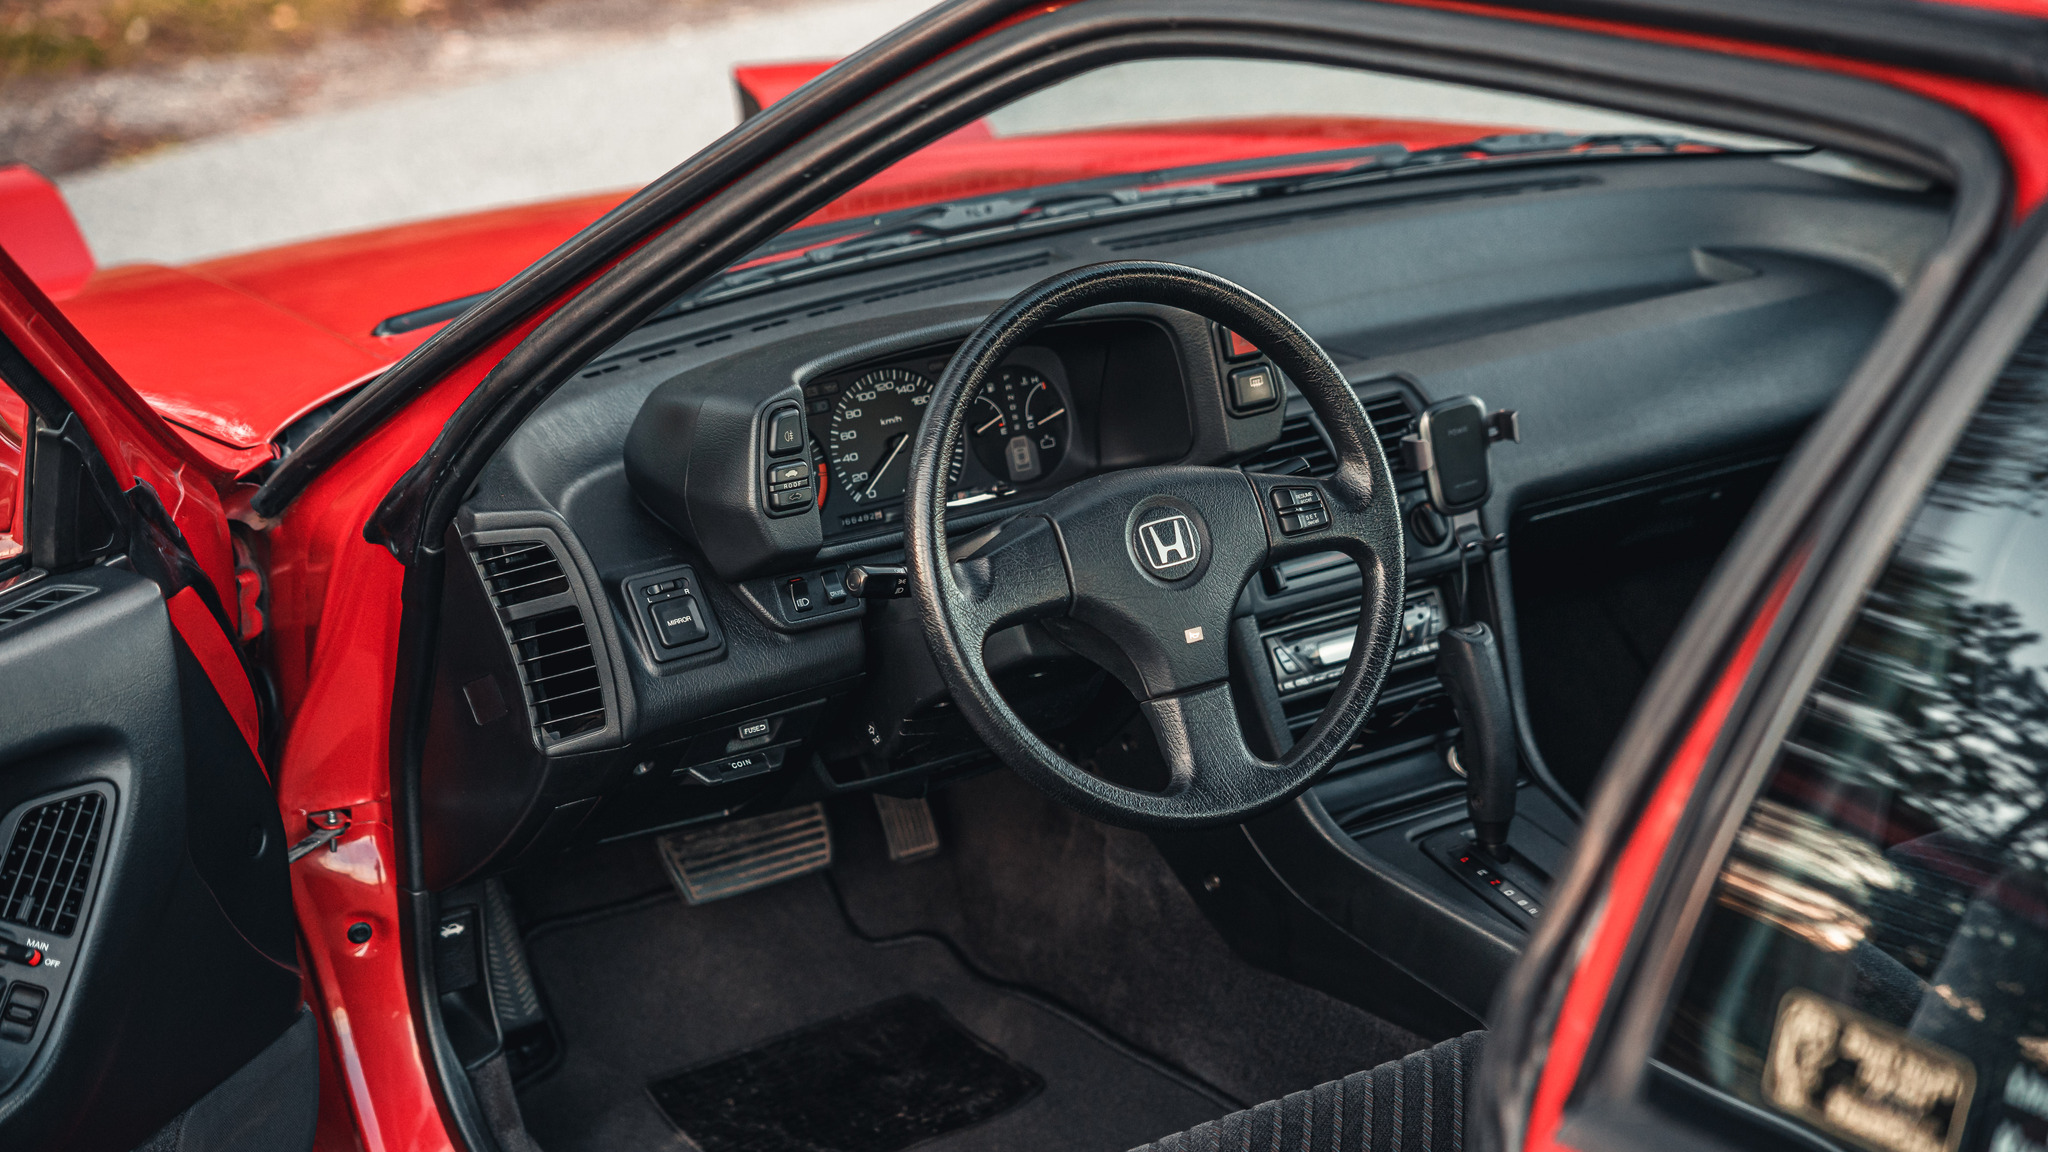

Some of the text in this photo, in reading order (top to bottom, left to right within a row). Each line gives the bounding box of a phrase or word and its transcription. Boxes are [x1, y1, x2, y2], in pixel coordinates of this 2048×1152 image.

[874, 381, 894, 392] 120
[895, 383, 915, 394] 140
[856, 391, 876, 401] 100
[911, 394, 930, 406] 160
[845, 409, 862, 419] 80
[880, 415, 902, 426] km/h
[840, 430, 857, 441] 60
[842, 452, 859, 462] 40
[851, 471, 868, 483] 20
[783, 481, 802, 490] ROOF
[867, 489, 877, 499] 0
[1305, 512, 1318, 521] SET
[666, 615, 692, 627] MIRROR
[744, 725, 760, 735] FUSE
[731, 759, 752, 769] COIN
[26, 938, 50, 951] MAIN
[44, 958, 61, 968] OFF
